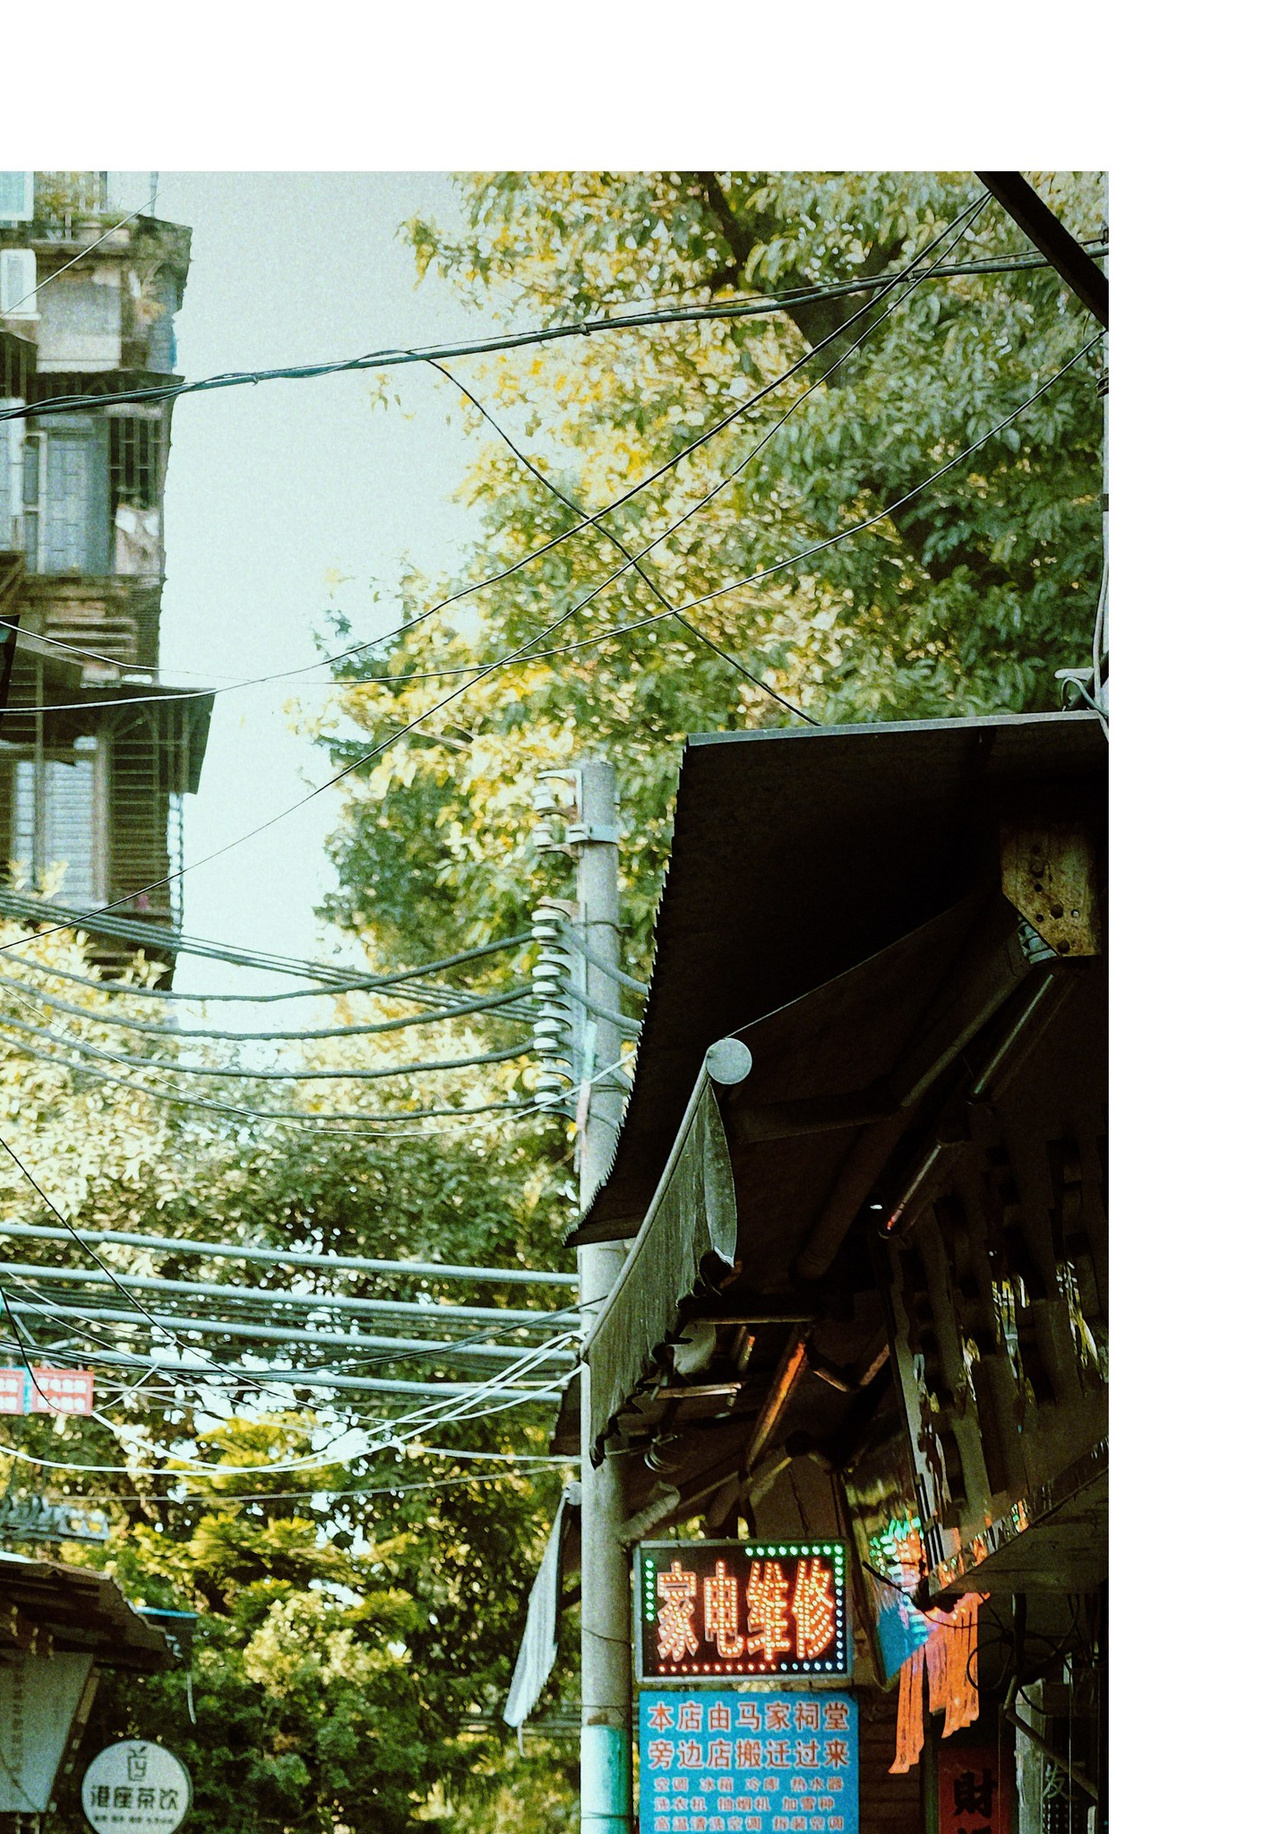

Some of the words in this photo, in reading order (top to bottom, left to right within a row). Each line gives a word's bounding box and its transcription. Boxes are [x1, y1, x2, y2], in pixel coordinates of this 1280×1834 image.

[657, 1559, 834, 1662] 家电维修
[648, 1700, 850, 1732] 本店由马家祠堂
[648, 1737, 850, 1769] 旁边店搬迁过来
